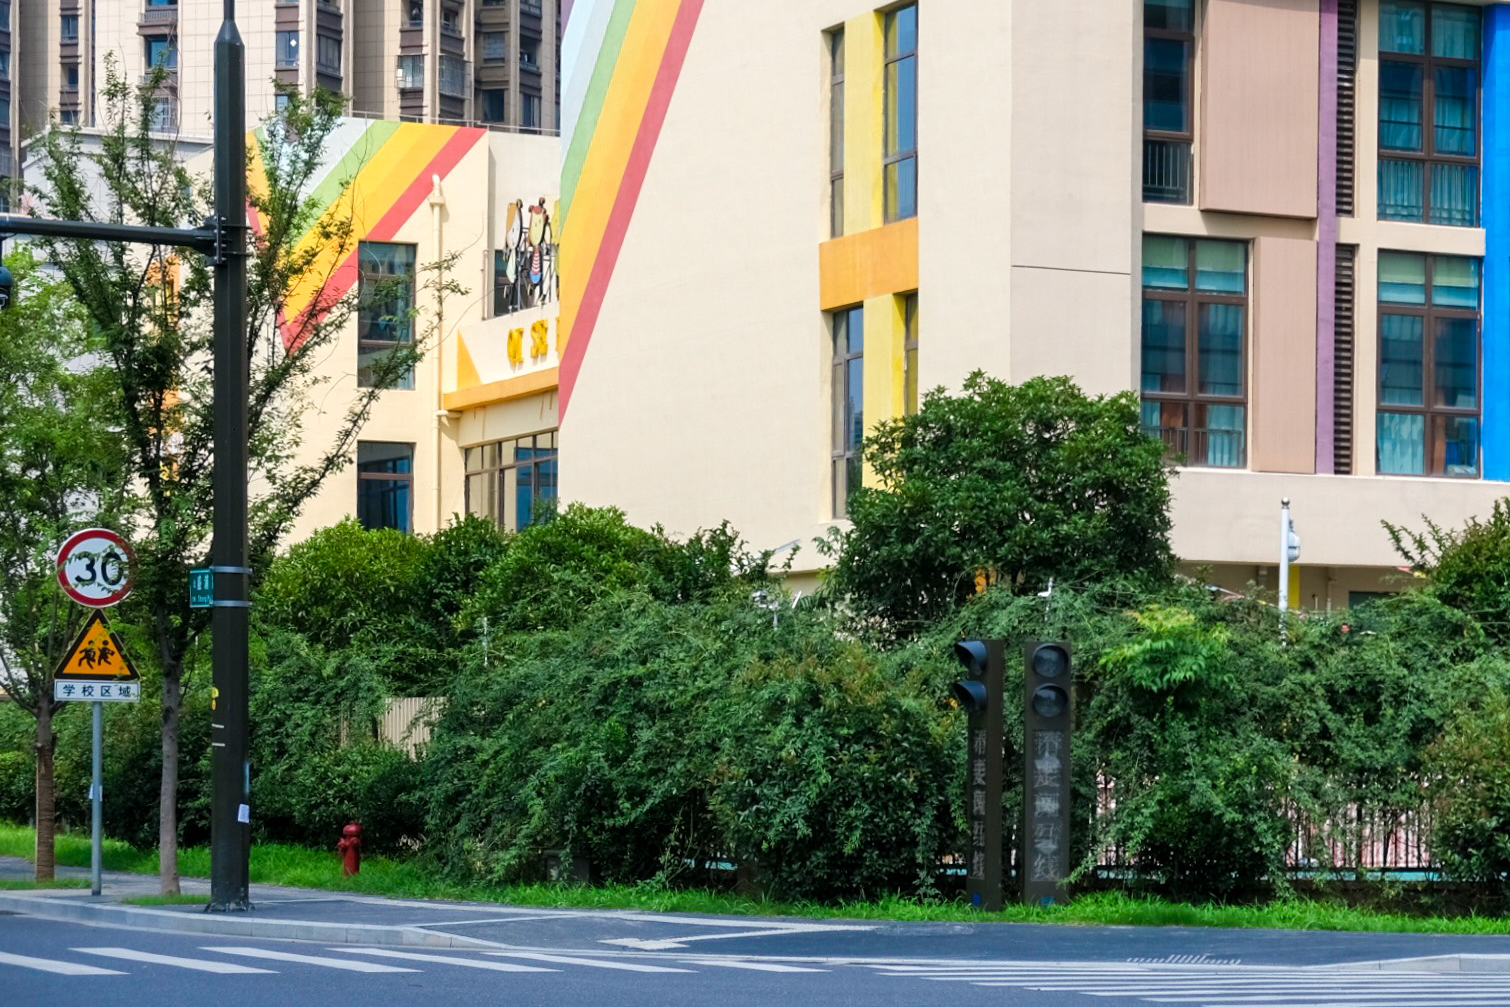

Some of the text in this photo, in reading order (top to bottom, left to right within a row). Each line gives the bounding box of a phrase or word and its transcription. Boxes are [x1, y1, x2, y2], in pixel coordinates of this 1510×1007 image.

[74, 551, 124, 586] 30
[63, 684, 132, 697] 学校区域
